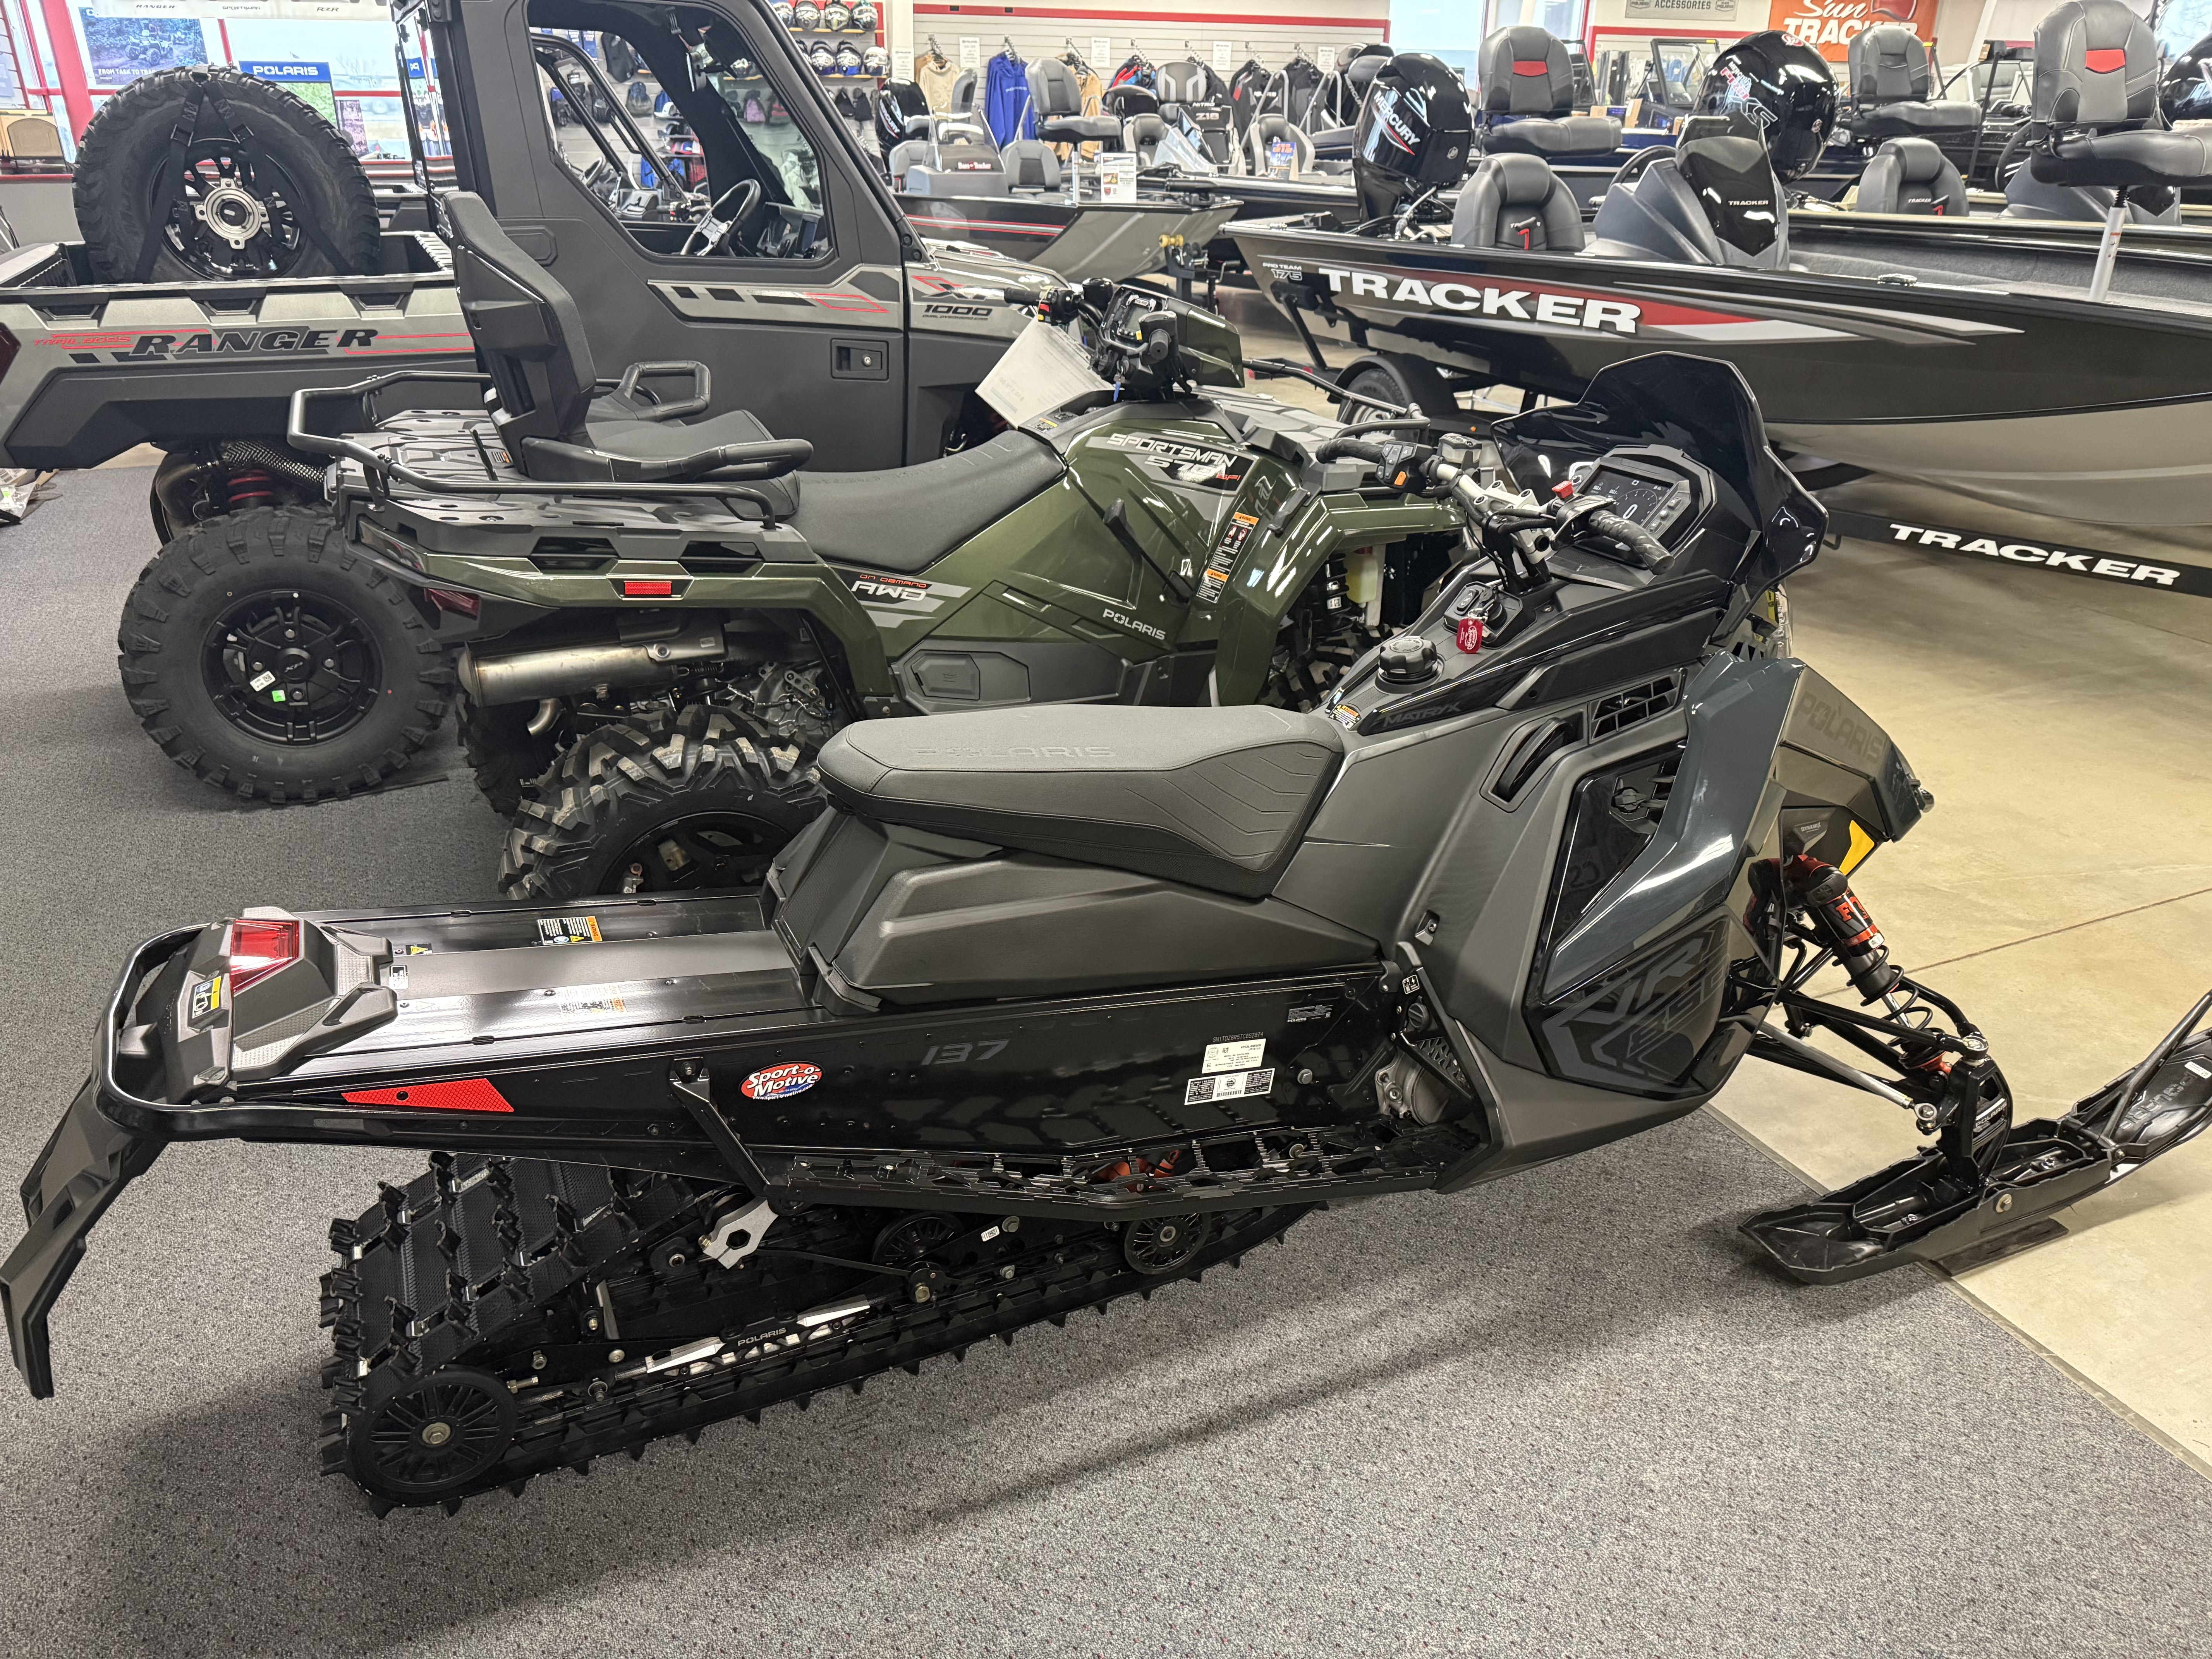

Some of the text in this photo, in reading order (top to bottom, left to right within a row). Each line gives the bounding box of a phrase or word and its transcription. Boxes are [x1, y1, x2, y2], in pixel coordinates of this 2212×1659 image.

[1654, 0, 1711, 9] ACCESSORIES
[1793, 0, 1869, 18] Sun
[1783, 18, 1918, 45] TRAC
[252, 66, 318, 76] POLARIS
[1374, 90, 1420, 145] MERCURY
[1271, 269, 1303, 281] 175
[924, 304, 993, 316] 1000
[1318, 268, 1642, 334] TRACKER
[129, 329, 379, 356] RANGER
[1107, 433, 1238, 467] SPORTSMAN
[1144, 455, 1217, 477] 570
[1216, 473, 1242, 481] EFI
[1889, 524, 2181, 586] TRACKER
[851, 580, 927, 601] AWD
[880, 577, 927, 588] DEMAND
[1102, 608, 1166, 641] POLARIS
[1383, 702, 1462, 727] MATRYX
[1793, 690, 1883, 764] POLARIS
[1801, 821, 1821, 832] DYNAMIX
[921, 1039, 1012, 1066] 137
[753, 1074, 819, 1097] Motive
[1975, 1101, 2007, 1128] POLARIS
[737, 1327, 787, 1346] POLARIS
